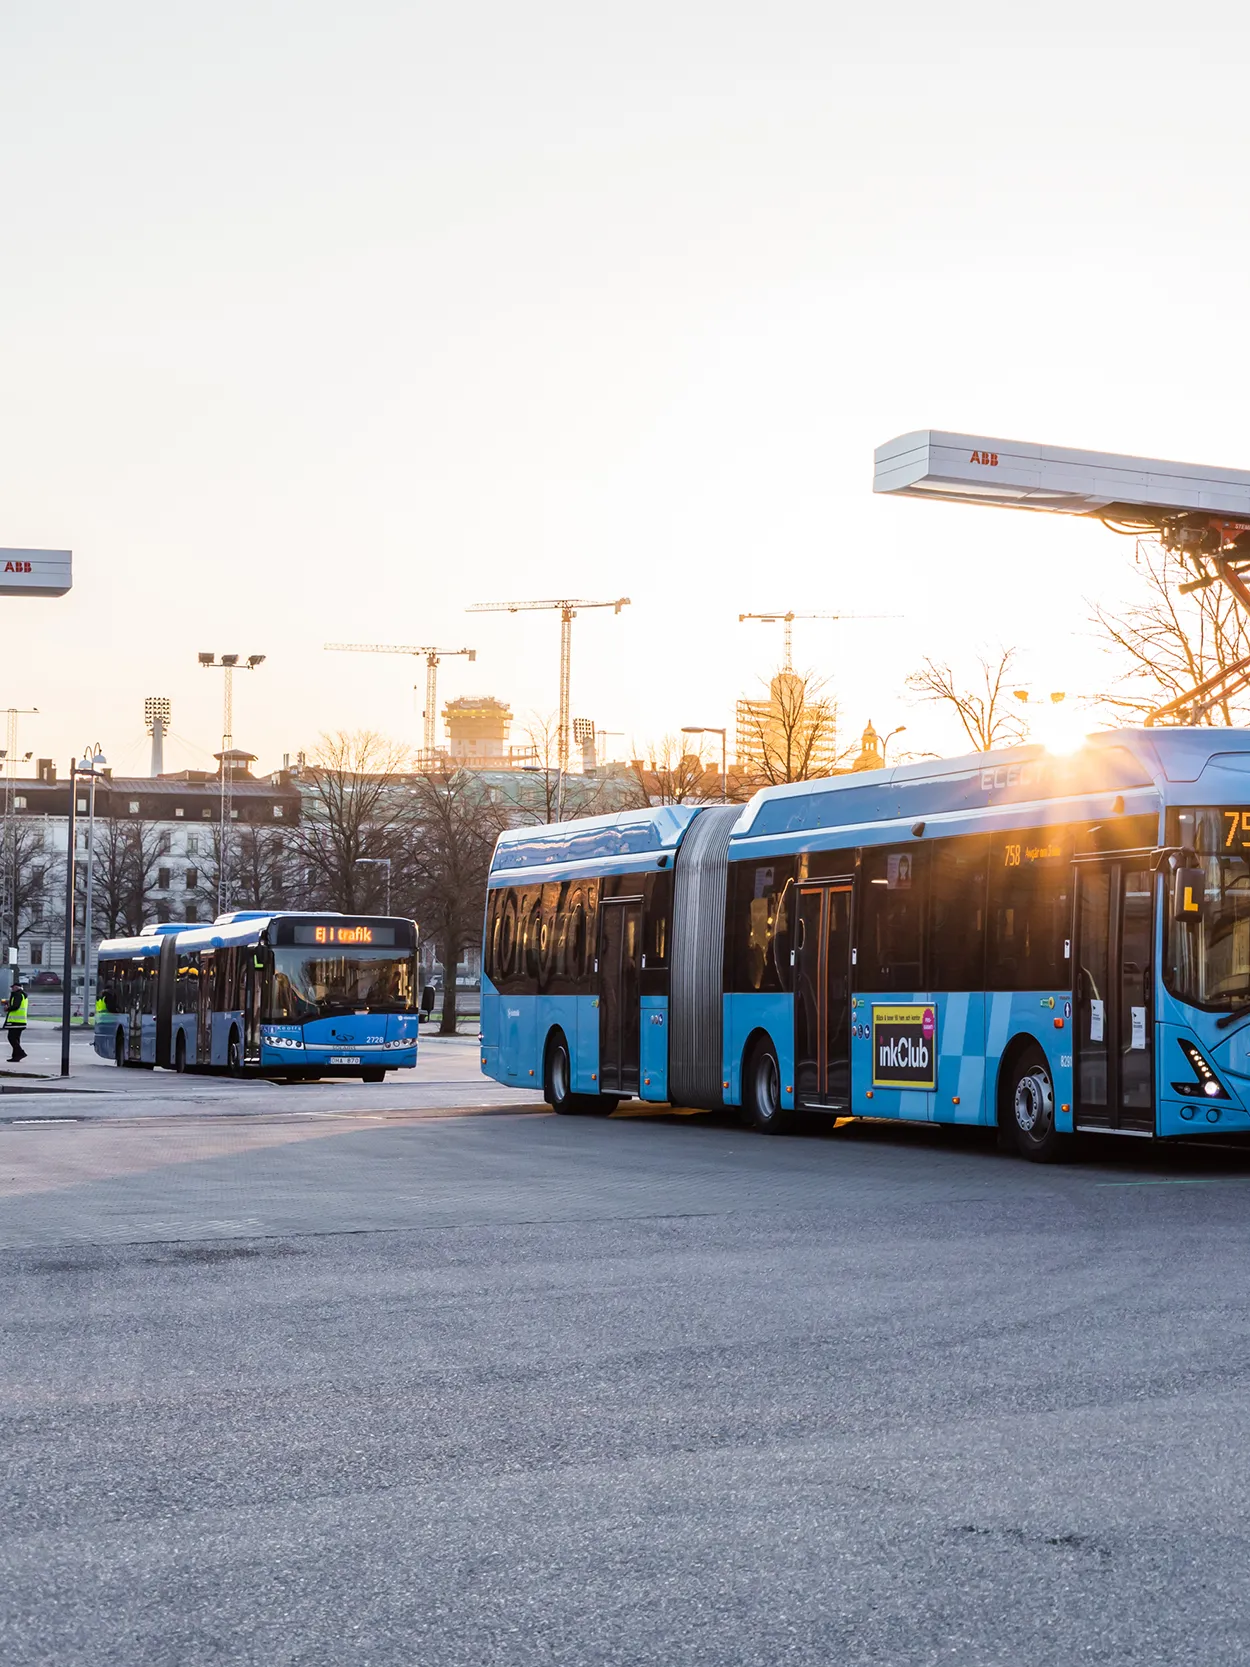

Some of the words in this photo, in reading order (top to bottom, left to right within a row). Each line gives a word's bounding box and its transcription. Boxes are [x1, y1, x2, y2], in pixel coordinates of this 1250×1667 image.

[970, 450, 999, 466] ABB
[4, 561, 32, 573] ABB
[1004, 845, 1021, 867] 758
[315, 927, 326, 943] Ej
[337, 926, 372, 942] trafik
[366, 1036, 384, 1044] 2728
[880, 1036, 929, 1068] inkClub
